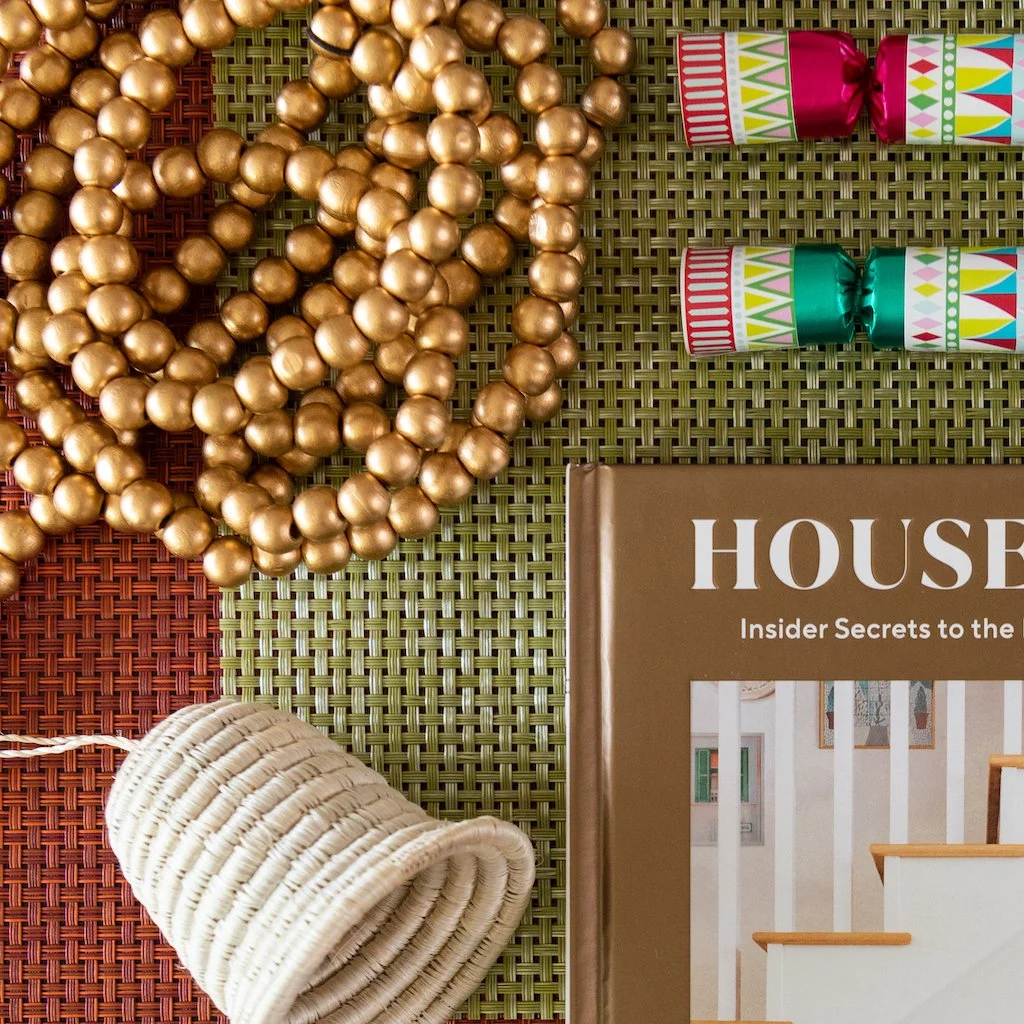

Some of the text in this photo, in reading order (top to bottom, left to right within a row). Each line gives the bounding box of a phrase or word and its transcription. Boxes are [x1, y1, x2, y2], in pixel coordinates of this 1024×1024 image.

[741, 617, 829, 640] Insider
[834, 617, 931, 640] Secrets
[937, 619, 965, 639] to
[970, 617, 1015, 639] the
